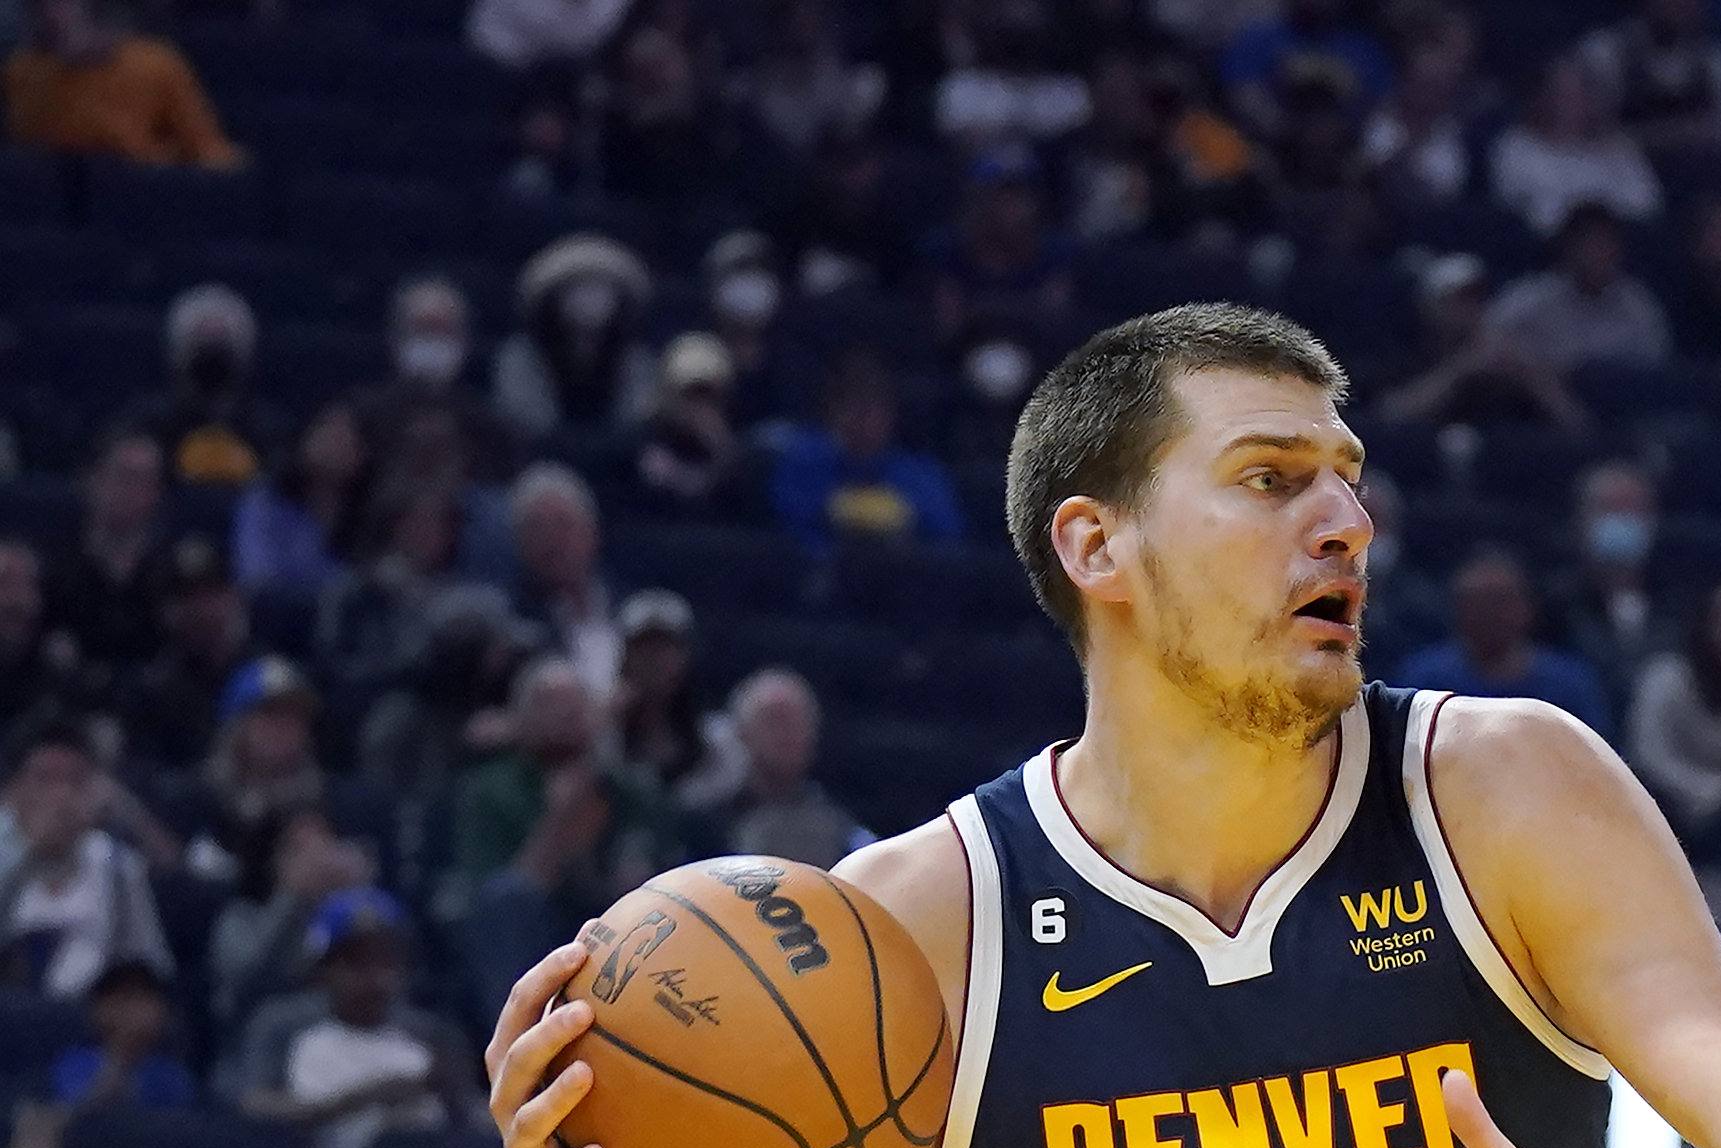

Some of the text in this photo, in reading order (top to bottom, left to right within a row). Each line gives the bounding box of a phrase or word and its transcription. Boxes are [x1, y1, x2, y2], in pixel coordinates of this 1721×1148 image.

[1030, 896, 1068, 944] 6
[1340, 880, 1429, 933] WU
[1349, 925, 1436, 957] Western
[1367, 947, 1428, 972] Union
